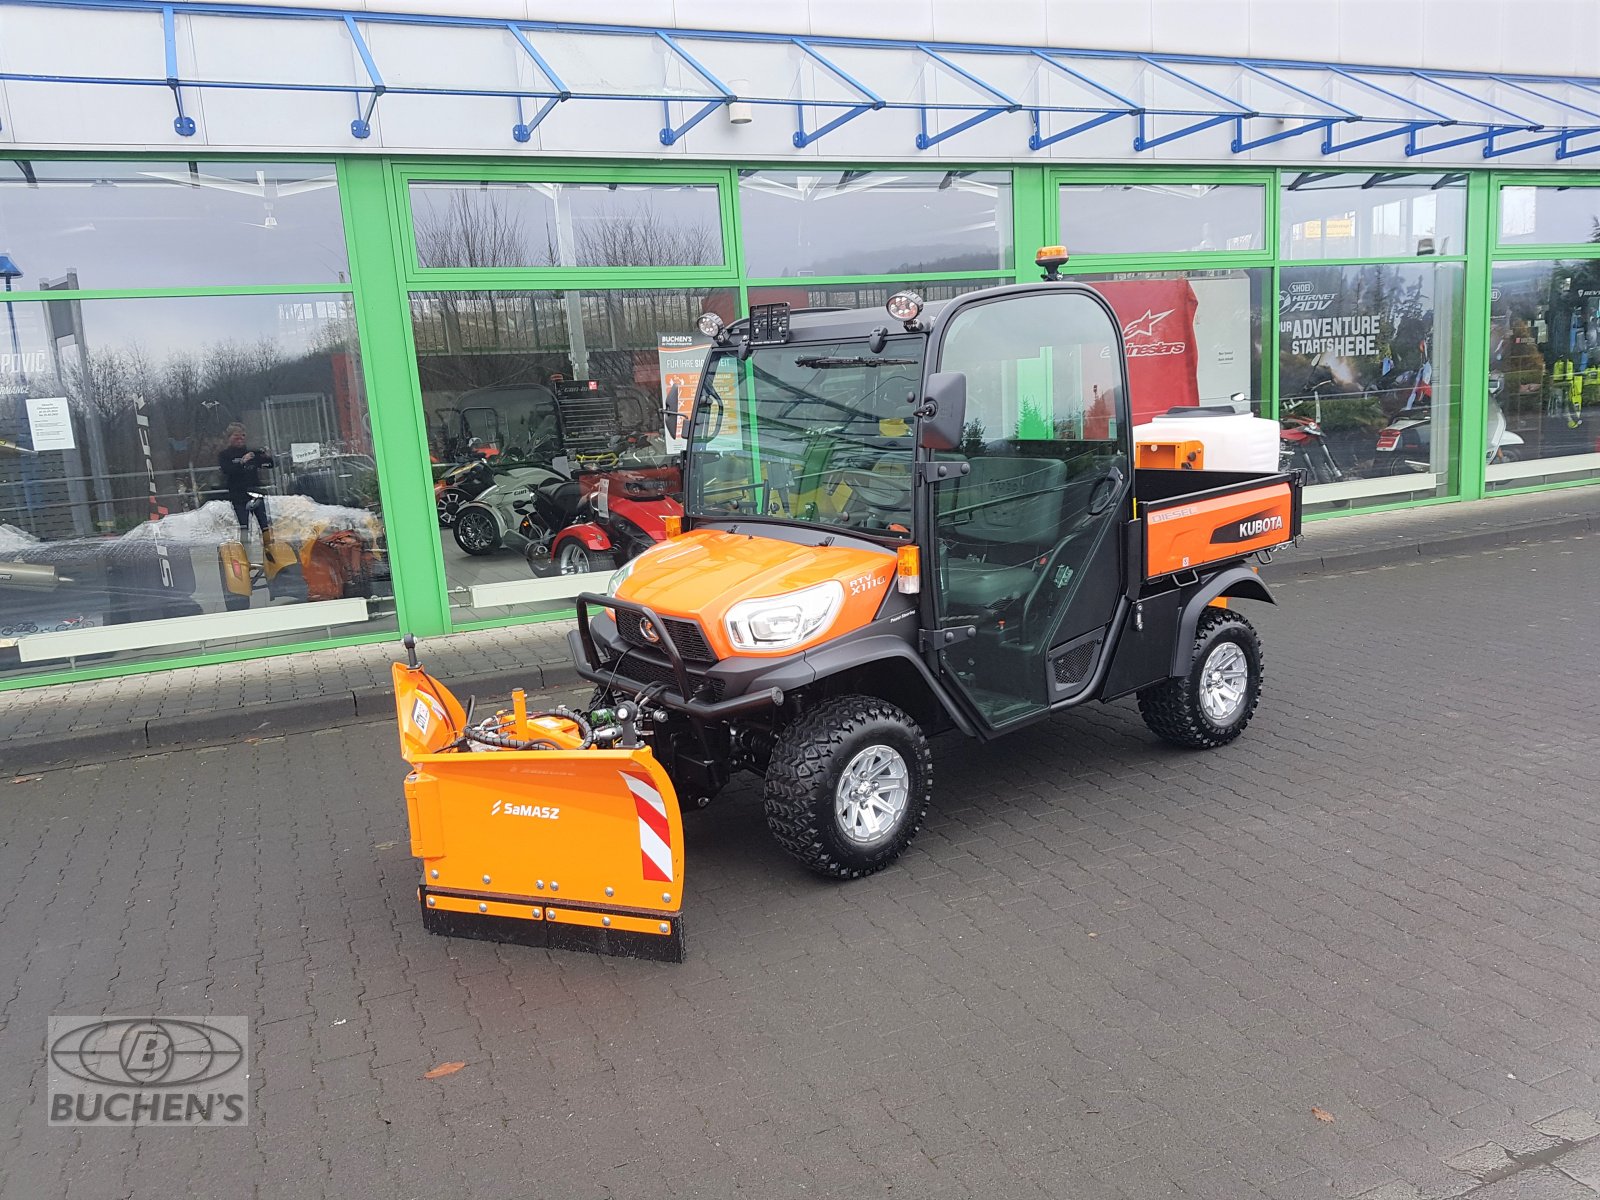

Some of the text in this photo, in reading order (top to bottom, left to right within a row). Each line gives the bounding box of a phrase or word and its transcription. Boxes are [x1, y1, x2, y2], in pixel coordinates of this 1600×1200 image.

[1291, 284, 1311, 293] SHOEI
[1292, 293, 1338, 302] HORNET
[1289, 300, 1334, 312] ADV
[1292, 315, 1381, 339] ADVENTURE
[1292, 335, 1380, 357] STARTS HERE.
[666, 359, 680, 369] FÜR
[1152, 508, 1195, 523] DIESEL
[1239, 515, 1283, 537] KUBOTA
[850, 574, 872, 588] RTV
[504, 802, 560, 820] SaMASZ
